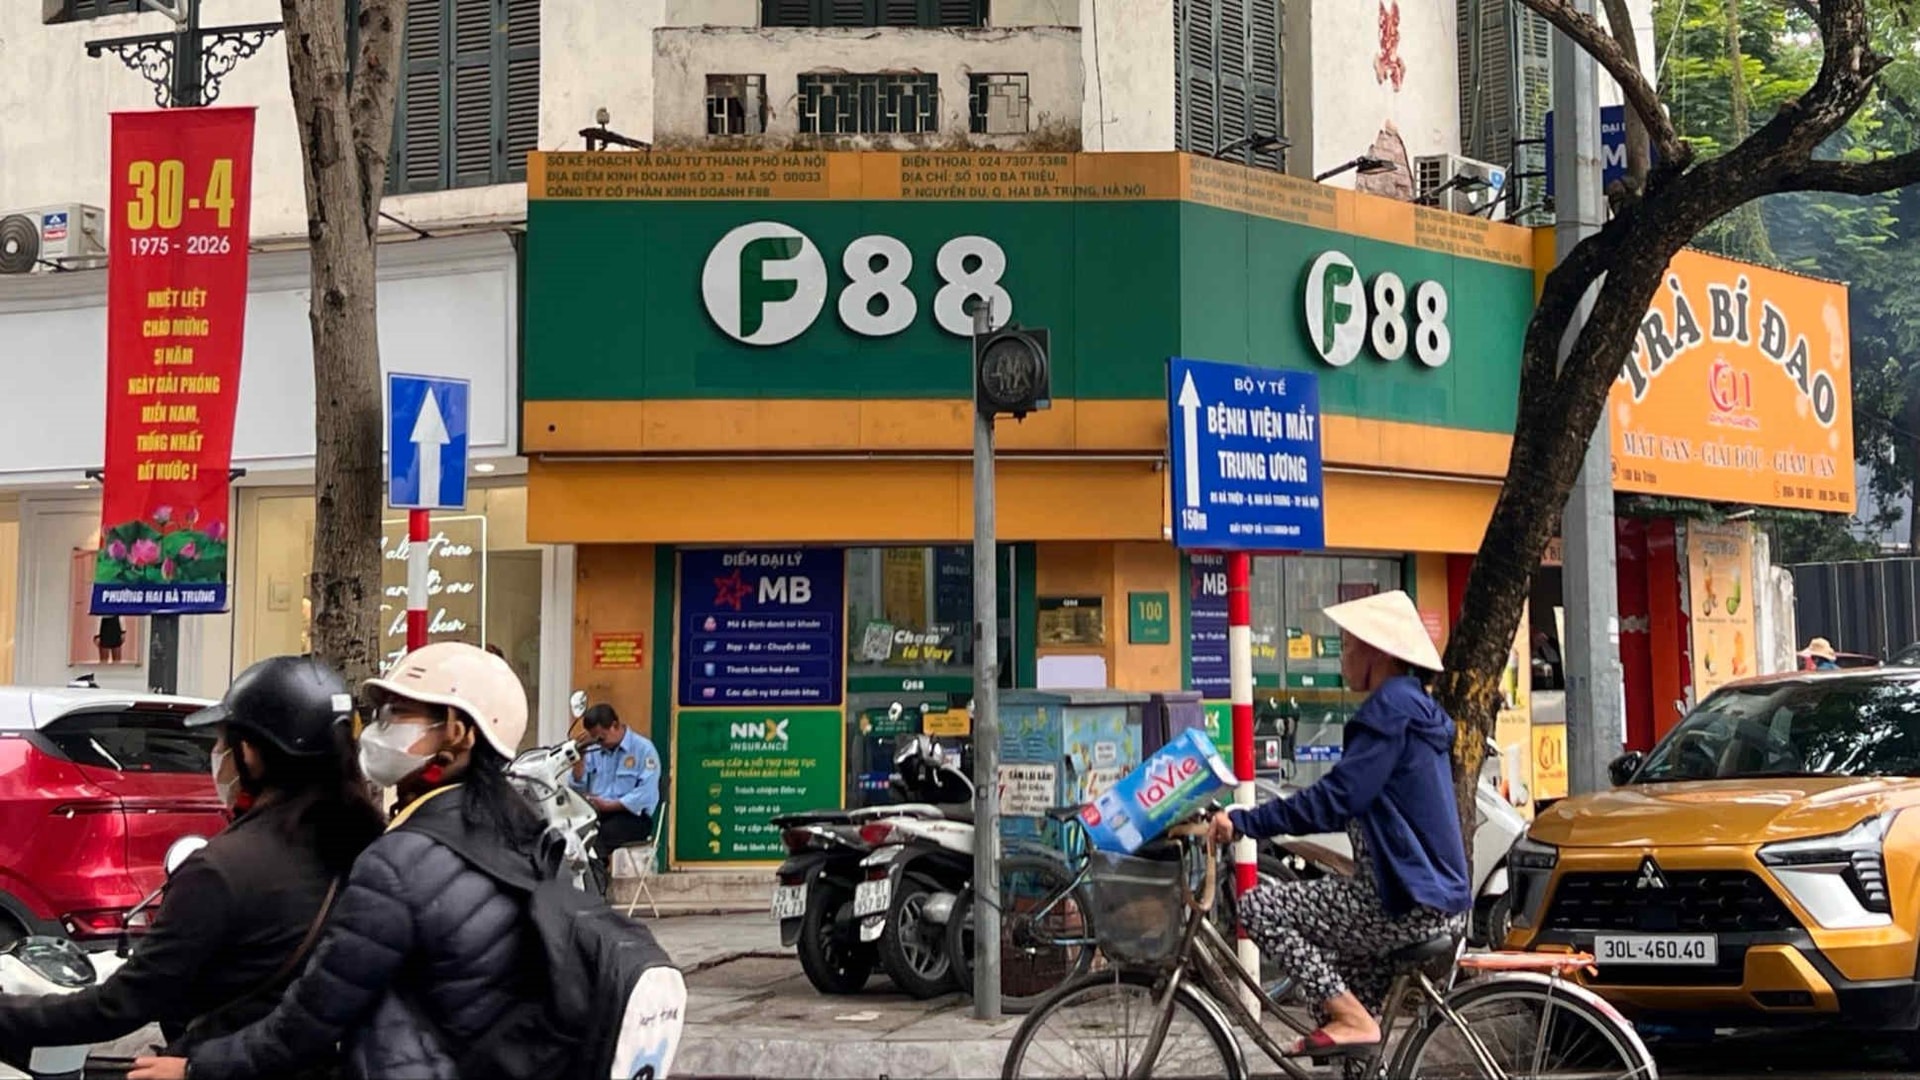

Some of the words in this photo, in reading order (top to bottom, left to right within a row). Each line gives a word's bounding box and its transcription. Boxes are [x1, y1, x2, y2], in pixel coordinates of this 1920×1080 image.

[783, 154, 801, 167] HÀ
[1603, 143, 1627, 169] M
[607, 171, 638, 182] KINH
[641, 171, 687, 182] DOANH
[976, 172, 997, 183] 100
[1000, 169, 1017, 183] BÀ
[127, 159, 235, 230] 30-4
[547, 184, 583, 198] CÔNG
[586, 186, 604, 197] TY
[665, 187, 697, 198] KINH
[700, 187, 745, 198] DOANH
[1103, 184, 1121, 197] HÀ
[131, 237, 169, 255] 1975
[186, 236, 231, 255] 2026
[702, 221, 1012, 345] F88
[181, 289, 207, 312] LIỆT
[1305, 250, 1451, 367] F88
[1618, 276, 1701, 400] TRÀ
[1709, 278, 1749, 342] BÍ
[1760, 302, 1836, 424] ĐAO
[1234, 376, 1254, 396] BỘ
[1257, 381, 1266, 393] Y
[1269, 377, 1287, 396] TẾ
[1207, 401, 1247, 440] BỆNH
[1250, 405, 1283, 443] VIỆN
[1285, 404, 1314, 442] MẮT
[1218, 450, 1266, 481] TRUNG
[1269, 452, 1308, 484] ƯƠNG
[1182, 508, 1207, 531] 150m
[723, 550, 757, 566] ĐIỂM
[760, 553, 784, 569] ĐẠI
[787, 552, 803, 566] LÝ
[758, 576, 812, 604] MB
[1202, 572, 1228, 596] MB
[102, 587, 144, 604] PHƯỜNG
[145, 589, 163, 603] HAI
[165, 587, 179, 603] BÀ
[181, 588, 216, 603] TRƯNG
[1138, 602, 1163, 622] 100
[894, 629, 942, 648] Chạm
[923, 647, 953, 663] Vay
[730, 718, 789, 741] NNX
[730, 741, 789, 751] INSURANCE
[1605, 939, 1706, 960] 30L-460.40
